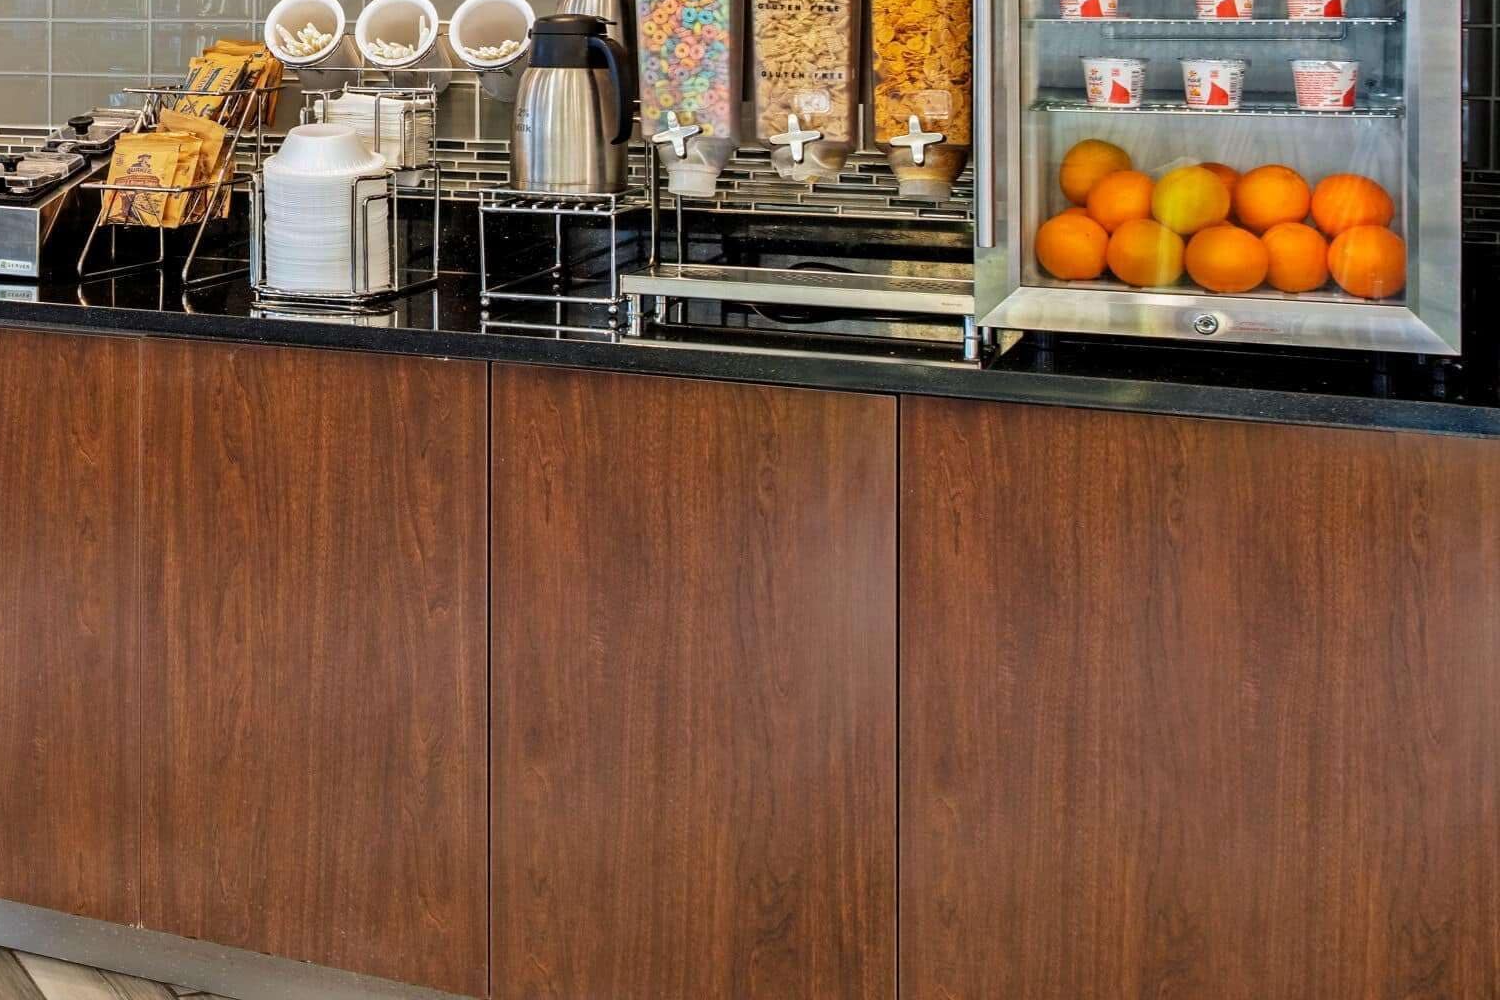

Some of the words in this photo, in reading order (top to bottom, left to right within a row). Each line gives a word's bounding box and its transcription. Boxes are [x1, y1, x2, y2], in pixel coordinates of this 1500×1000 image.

[757, 3, 801, 11] GLUTEN
[810, 4, 840, 12] FREE
[761, 71, 805, 79] GLUTEN
